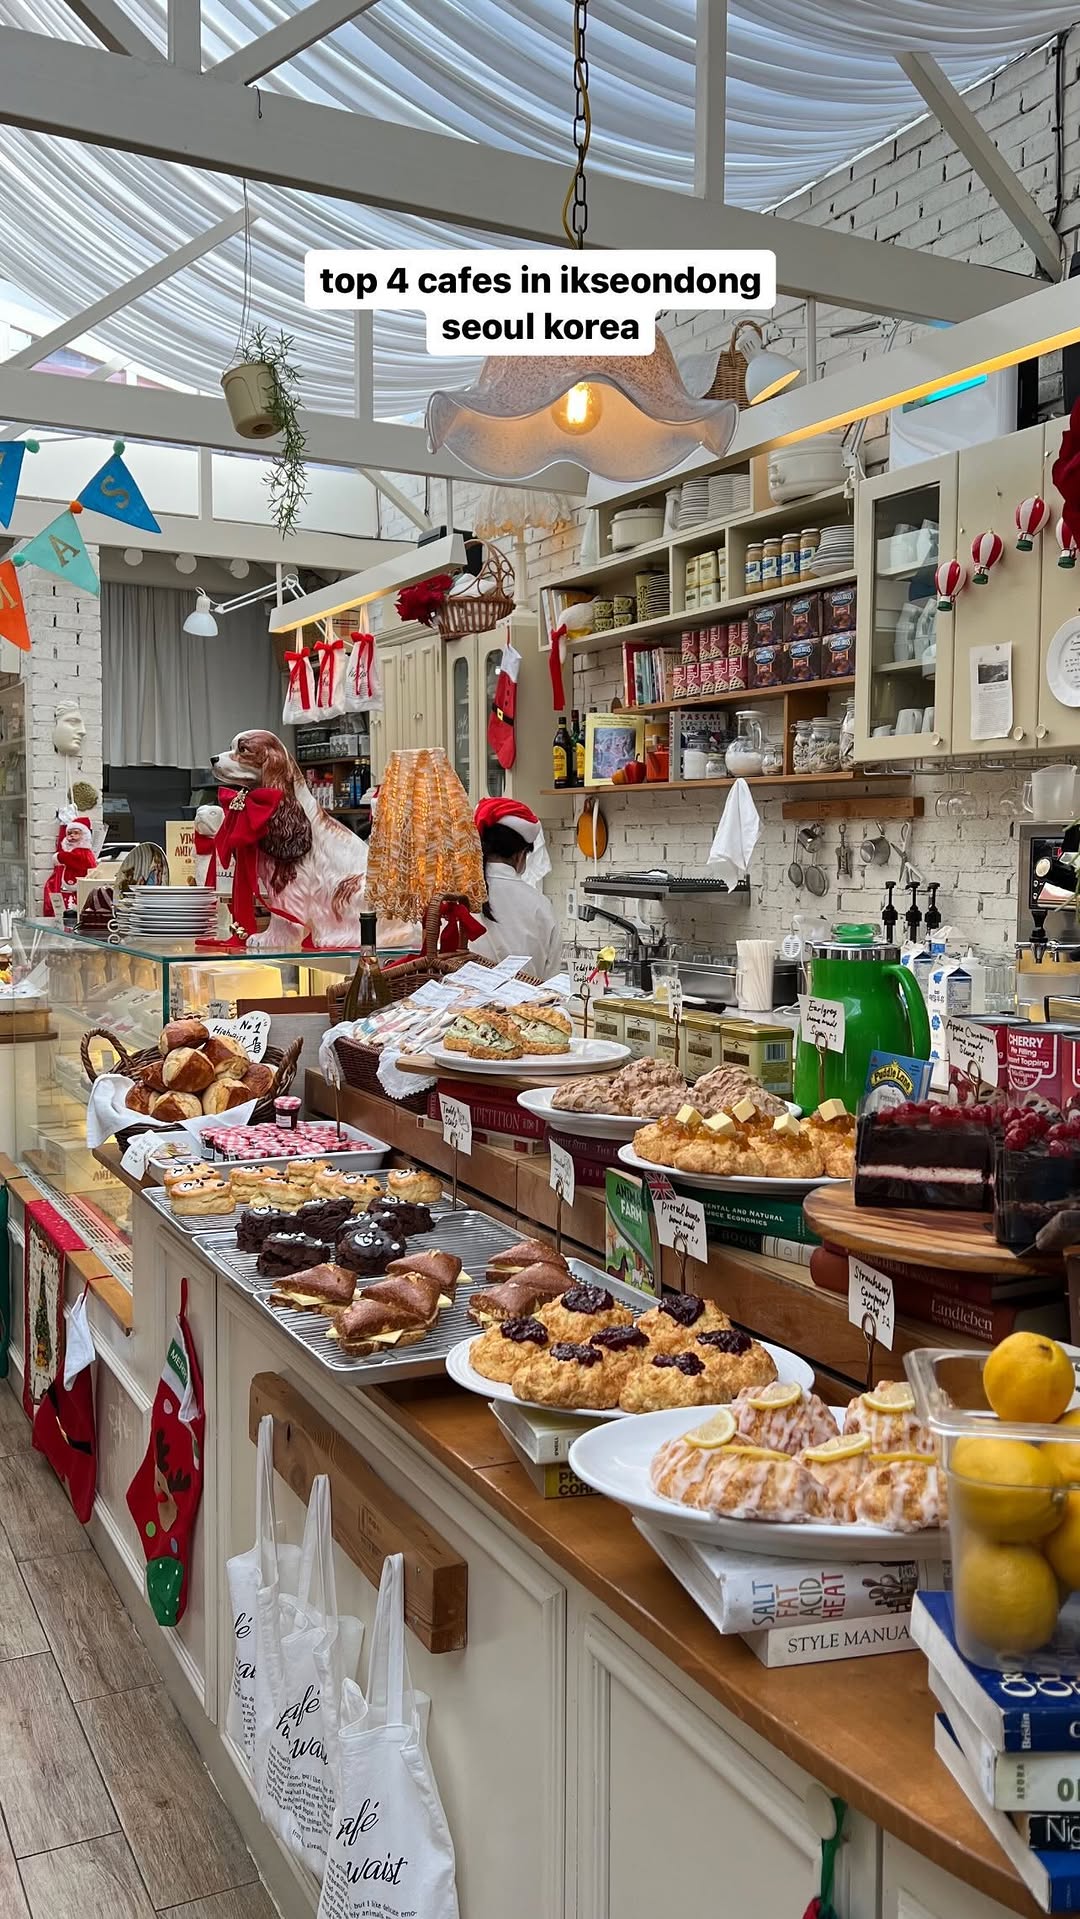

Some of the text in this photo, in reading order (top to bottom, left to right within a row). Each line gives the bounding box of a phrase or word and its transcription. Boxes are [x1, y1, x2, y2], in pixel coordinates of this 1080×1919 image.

[48, 475, 129, 568] A S
[680, 713, 721, 721] PASCAL
[1008, 1033, 1044, 1049] CHERRY
[1018, 1047, 1037, 1058] Filling
[1021, 1057, 1050, 1069] Topping
[620, 1198, 643, 1224] FARM
[726, 1213, 768, 1227] ECONOMICS
[732, 1207, 747, 1216] AND
[749, 1210, 785, 1222] NATURAL
[170, 1348, 188, 1381] MERR
[752, 1580, 775, 1626] SALT
[775, 1584, 799, 1618] FAT
[799, 1577, 824, 1617] ACID
[821, 1571, 846, 1619] HEAT
[787, 1624, 911, 1654] STYLE MANUA
[1057, 1777, 1080, 1802] O
[346, 1852, 408, 1886] waist
